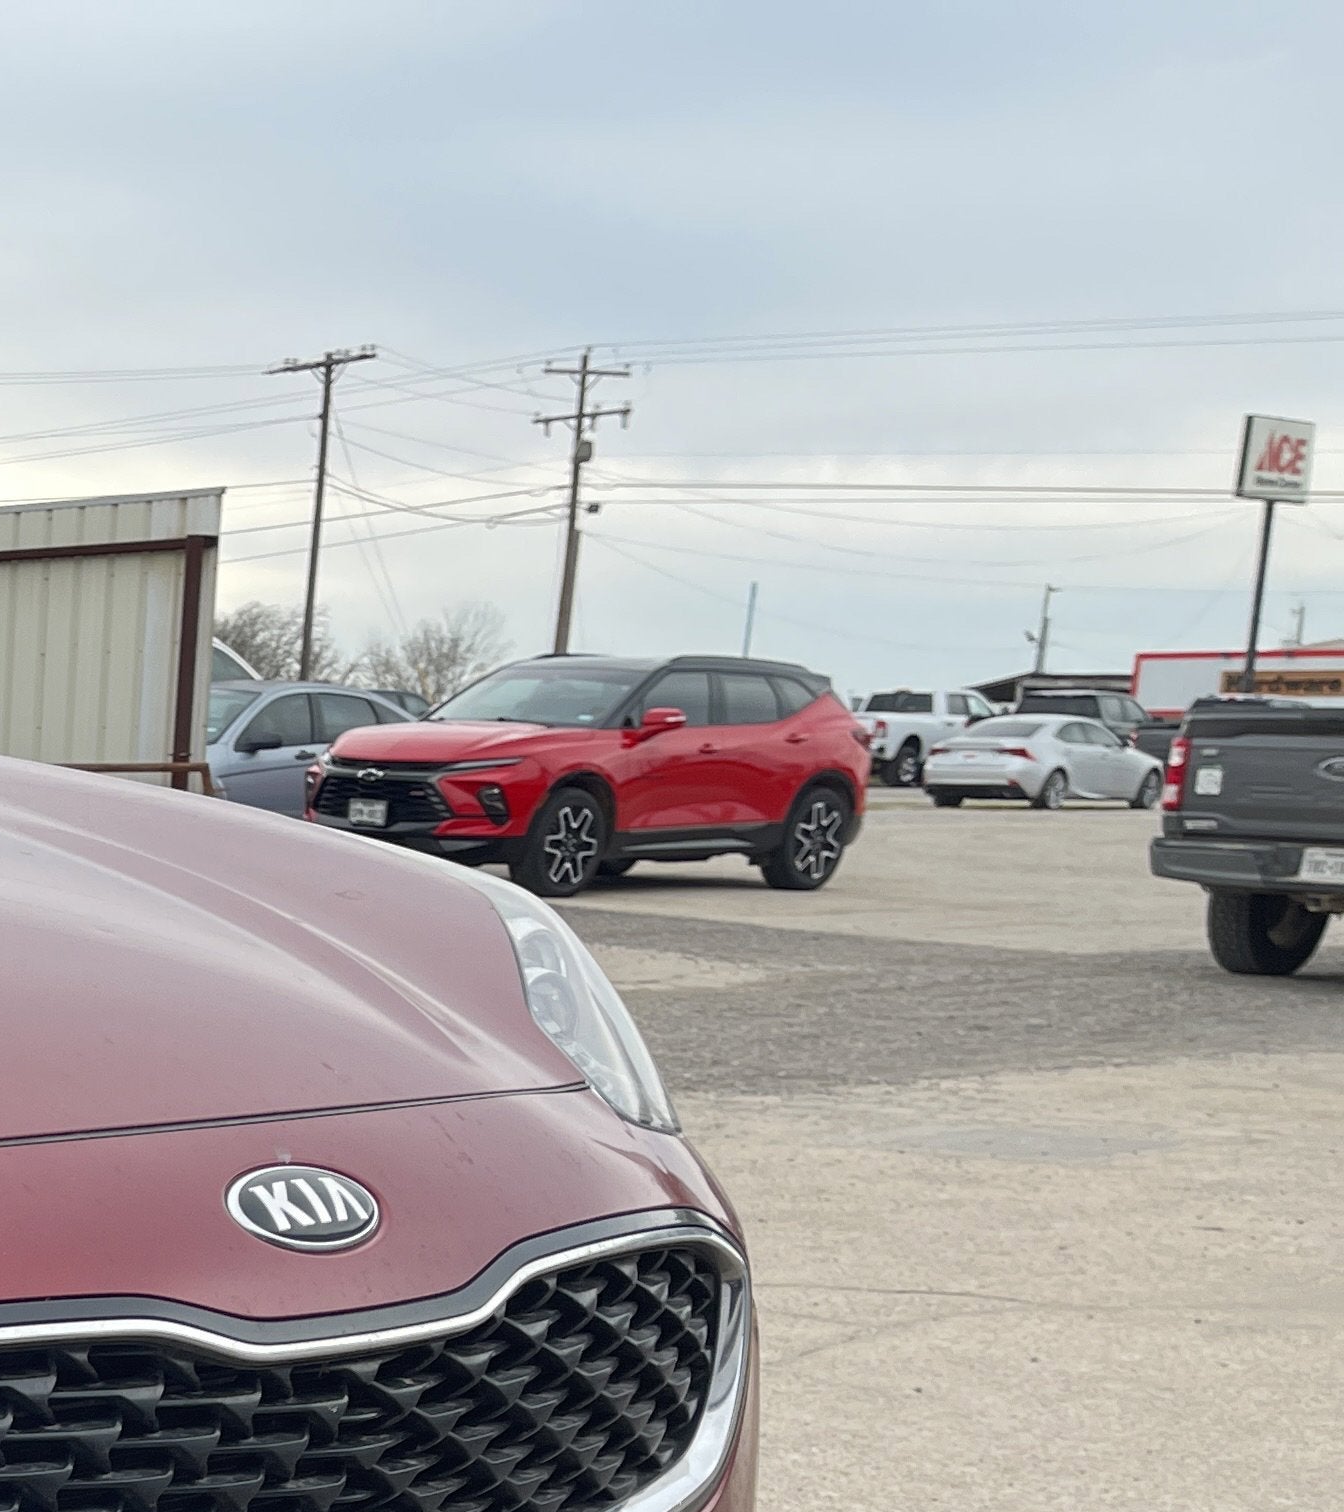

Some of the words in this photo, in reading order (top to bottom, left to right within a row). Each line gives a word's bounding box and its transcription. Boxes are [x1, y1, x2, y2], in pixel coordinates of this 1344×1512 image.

[1255, 432, 1308, 475] ACE
[1226, 674, 1342, 692] Hrdware
[248, 1176, 370, 1232] KIA
